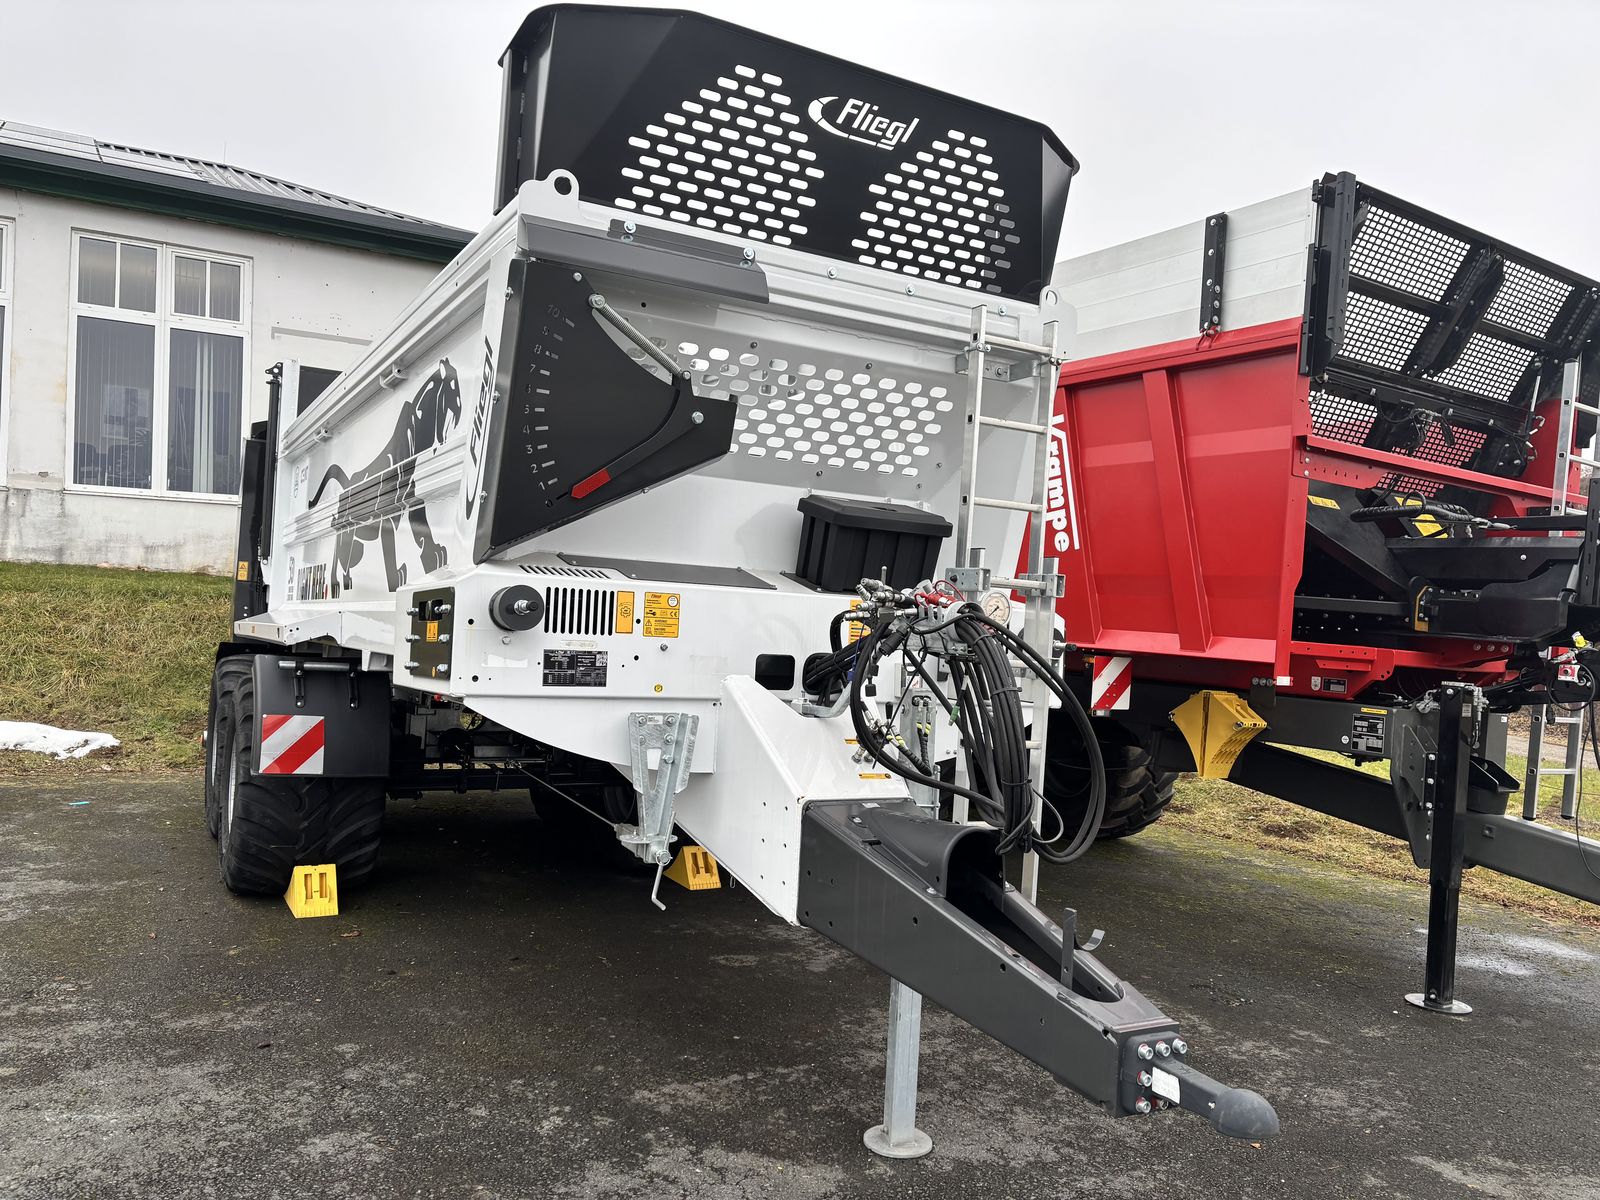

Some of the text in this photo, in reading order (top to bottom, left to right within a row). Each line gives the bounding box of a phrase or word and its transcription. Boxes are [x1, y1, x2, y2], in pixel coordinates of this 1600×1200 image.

[836, 98, 920, 146] Fliegl
[529, 364, 536, 373] 7
[470, 335, 494, 468] Fliegl
[524, 405, 531, 414] 5
[523, 425, 531, 434] 4
[526, 444, 533, 454] 3
[530, 464, 538, 473] 2
[538, 481, 546, 491] 1
[1045, 414, 1070, 552] Krampe
